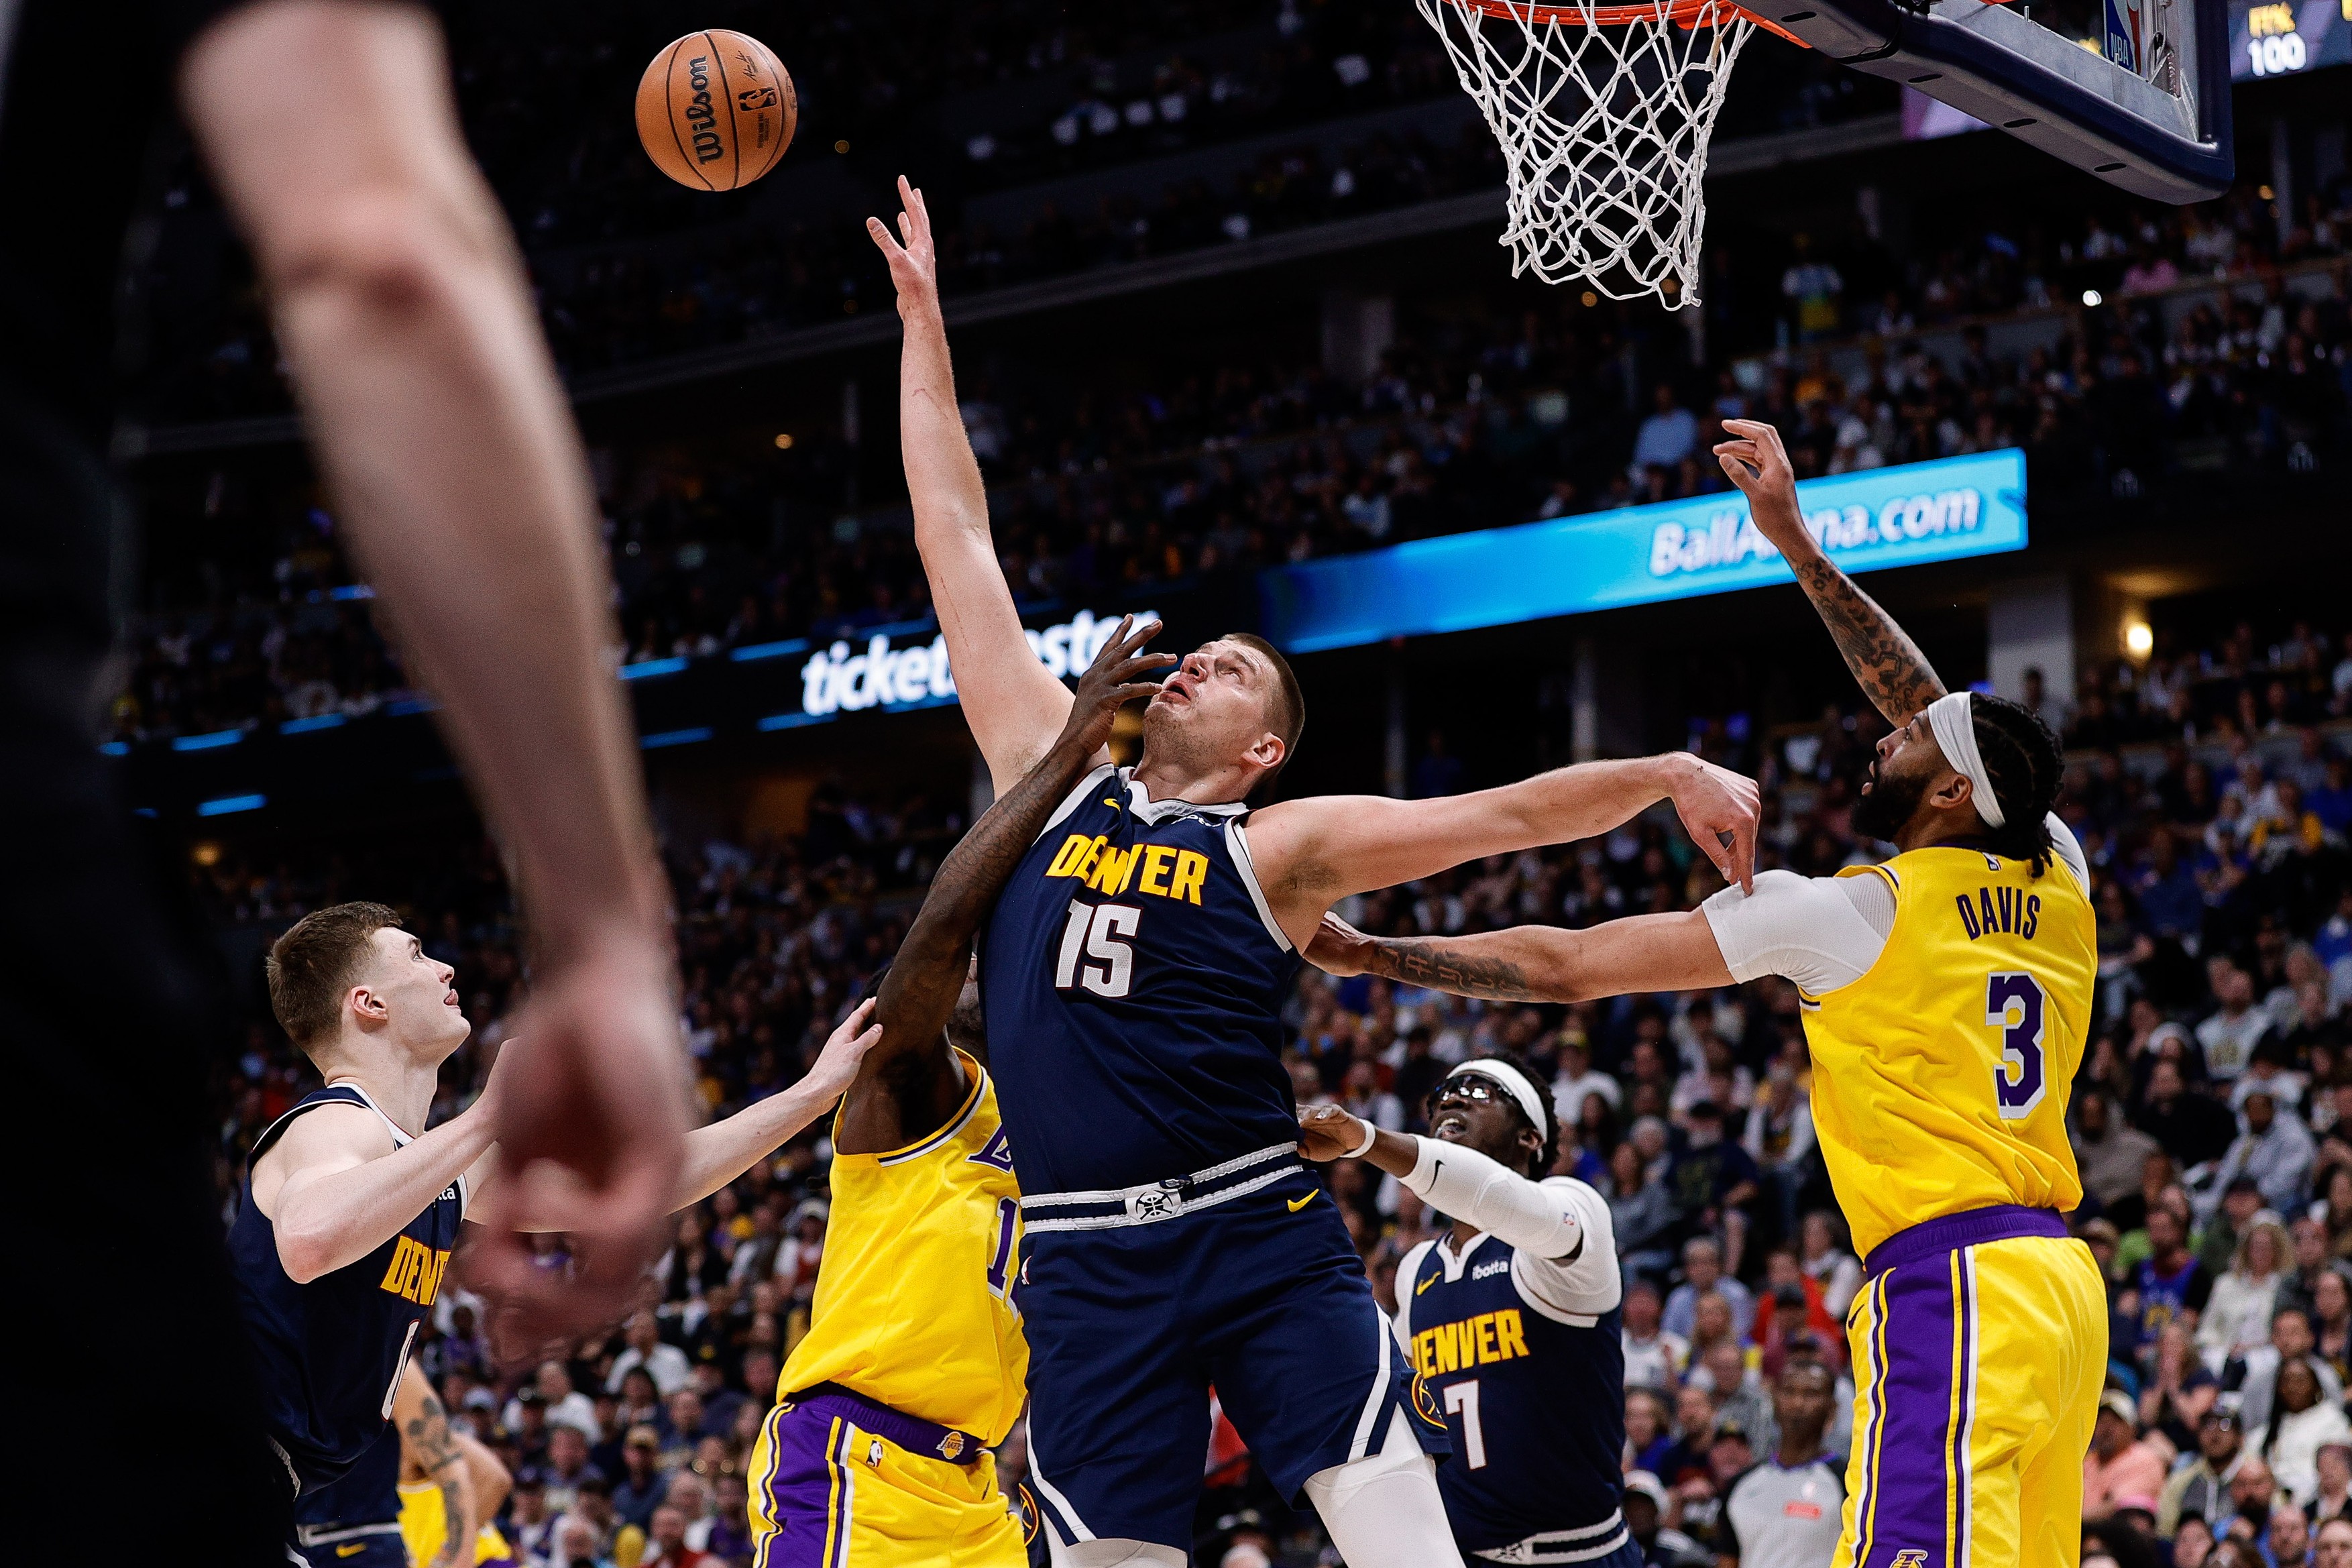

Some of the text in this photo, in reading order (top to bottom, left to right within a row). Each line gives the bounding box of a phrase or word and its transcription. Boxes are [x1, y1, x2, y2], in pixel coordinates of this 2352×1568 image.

[2111, 32, 2129, 66] NBA
[2247, 32, 2306, 76] 100
[685, 56, 724, 165] Wilson
[1649, 488, 1980, 576] BallAna.com
[1055, 898, 1144, 998] 15
[1955, 886, 2041, 940] DAVIS
[1985, 970, 2047, 1119] 3
[987, 1195, 1020, 1323] 1
[1443, 1379, 1488, 1470] 7
